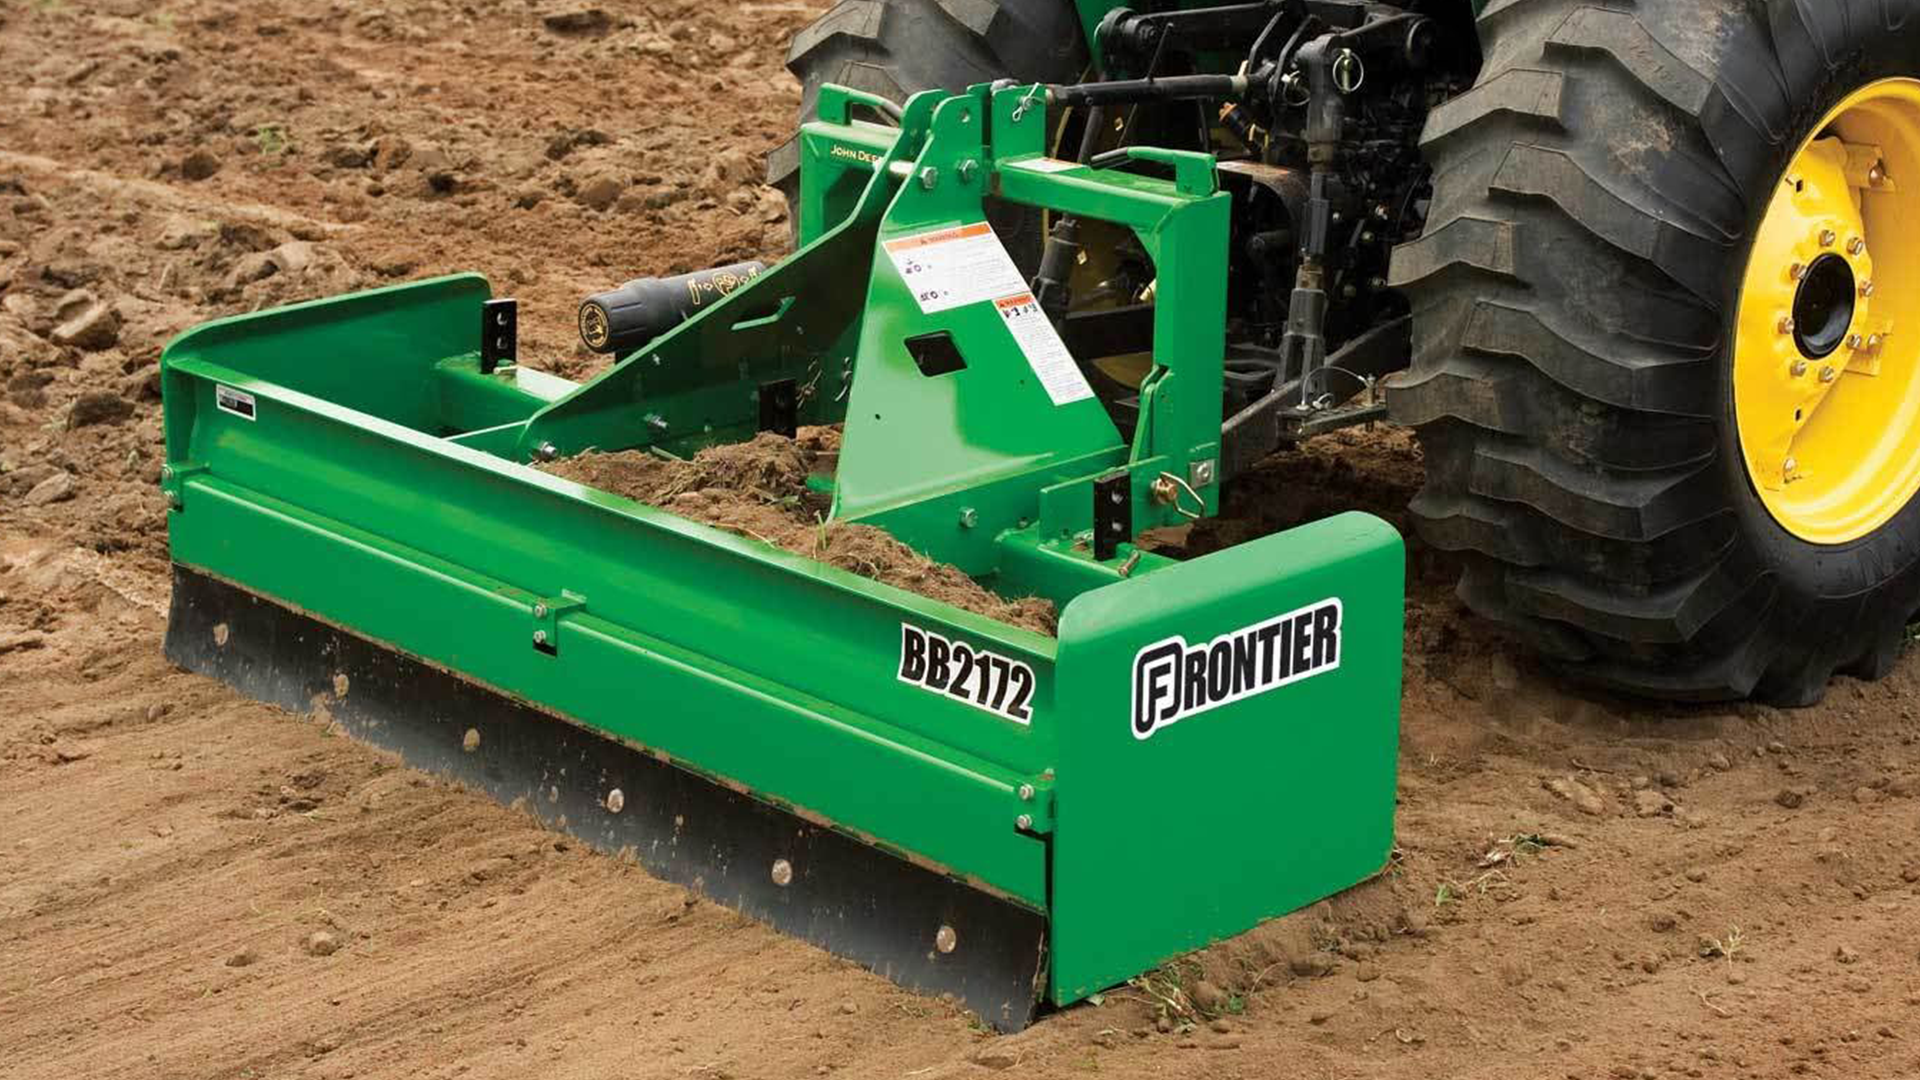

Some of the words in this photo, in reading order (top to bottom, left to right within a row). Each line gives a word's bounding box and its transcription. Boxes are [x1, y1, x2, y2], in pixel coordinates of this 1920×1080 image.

[830, 144, 857, 160] JOHN
[900, 626, 1033, 721] BB2172
[1134, 603, 1339, 734] FRONTIER
